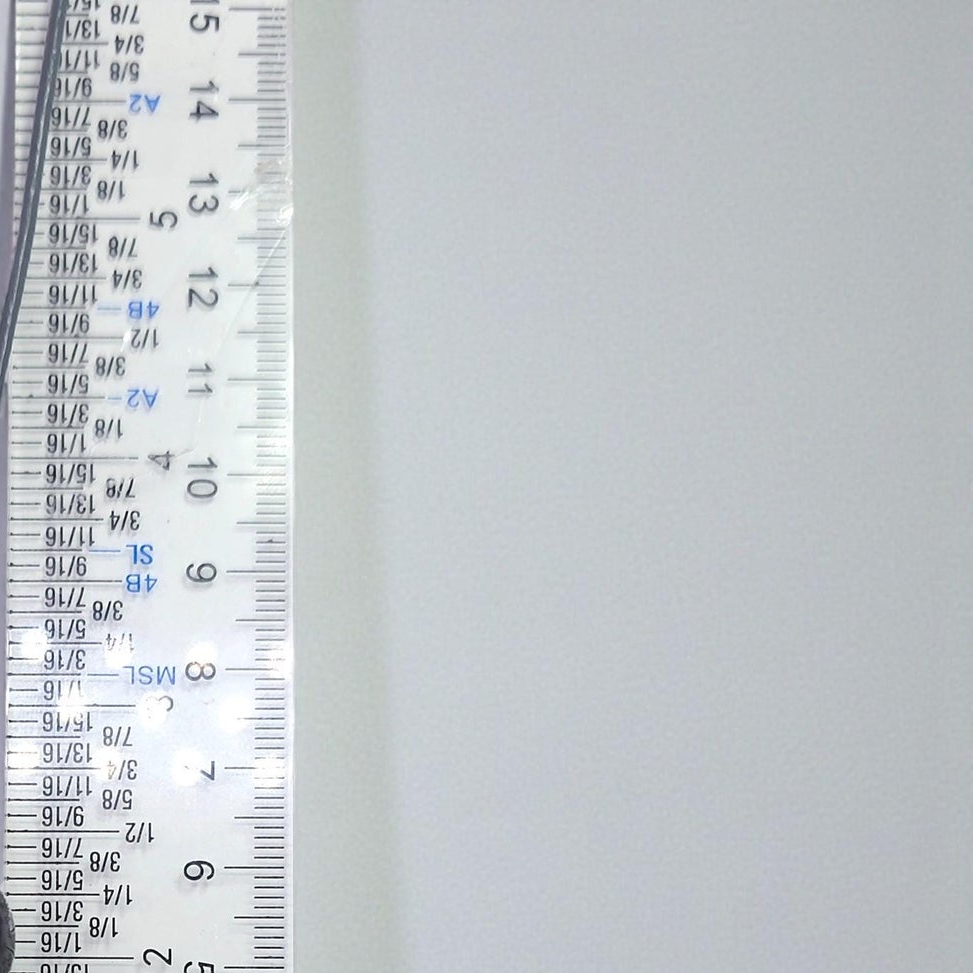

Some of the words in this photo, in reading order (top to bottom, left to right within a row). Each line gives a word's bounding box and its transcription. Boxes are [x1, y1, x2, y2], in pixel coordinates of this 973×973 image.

[111, 5, 140, 23] 7/8
[65, 19, 100, 39] 13/1
[115, 36, 144, 54] 3/4
[59, 49, 100, 70] 11/1
[111, 63, 139, 81] 5/8
[130, 95, 160, 113] A2
[190, 81, 219, 121] 14
[52, 107, 91, 126] 7/16
[98, 120, 127, 139] 3/8
[51, 137, 91, 156] 5/16
[112, 150, 139, 169] 1/4
[50, 166, 91, 185] 3/16
[97, 181, 125, 200] 1/8
[189, 173, 219, 213] 13
[50, 195, 89, 214] 1/16
[150, 211, 177, 229] 5
[49, 224, 97, 243] 15/16
[109, 237, 138, 257] 7/8
[49, 254, 97, 273] 13/16
[113, 270, 142, 289] 3/4
[189, 267, 218, 308] 12
[49, 286, 97, 305] 11/16
[128, 301, 159, 319] 4B
[48, 314, 89, 333] 9/16
[131, 329, 159, 348] 1/2
[48, 344, 88, 363] 7/16
[96, 357, 125, 376] 3/8
[48, 374, 88, 394] 5/16
[188, 363, 213, 394] 11
[127, 389, 158, 407] A2
[48, 404, 88, 423] 3/16
[95, 420, 123, 439] 1/8
[47, 434, 86, 453] 1/16
[148, 451, 175, 471] 4
[46, 464, 95, 483] 15/16
[188, 457, 218, 498] 10
[46, 494, 95, 514] 13/16
[110, 511, 140, 530] 3/4
[45, 527, 95, 547] 11/16
[126, 544, 153, 564] SL
[45, 556, 87, 576] 9/16
[186, 563, 216, 582] 9
[127, 574, 157, 593] 4B
[45, 588, 86, 607] 7/16
[93, 601, 123, 621] 3/8
[44, 619, 86, 639] 5/16
[44, 650, 85, 670] 3/16
[123, 666, 175, 685] MSL
[185, 662, 216, 681] 8
[43, 712, 93, 731] 15/16
[103, 726, 132, 746] 7/8
[43, 743, 92, 763] 13/16
[43, 776, 92, 796] 11/16
[103, 789, 132, 809] 5/8
[42, 806, 83, 826] 9/16
[126, 822, 154, 843] 1/2
[42, 838, 83, 858] 7/16
[90, 852, 120, 872] 3/8
[184, 860, 214, 880] 6
[42, 870, 83, 890] 5/16
[104, 885, 132, 905] 1/4
[41, 901, 83, 921] 3/16
[90, 917, 118, 938] 1/8
[41, 932, 81, 952] 1/16
[143, 949, 171, 965] 2
